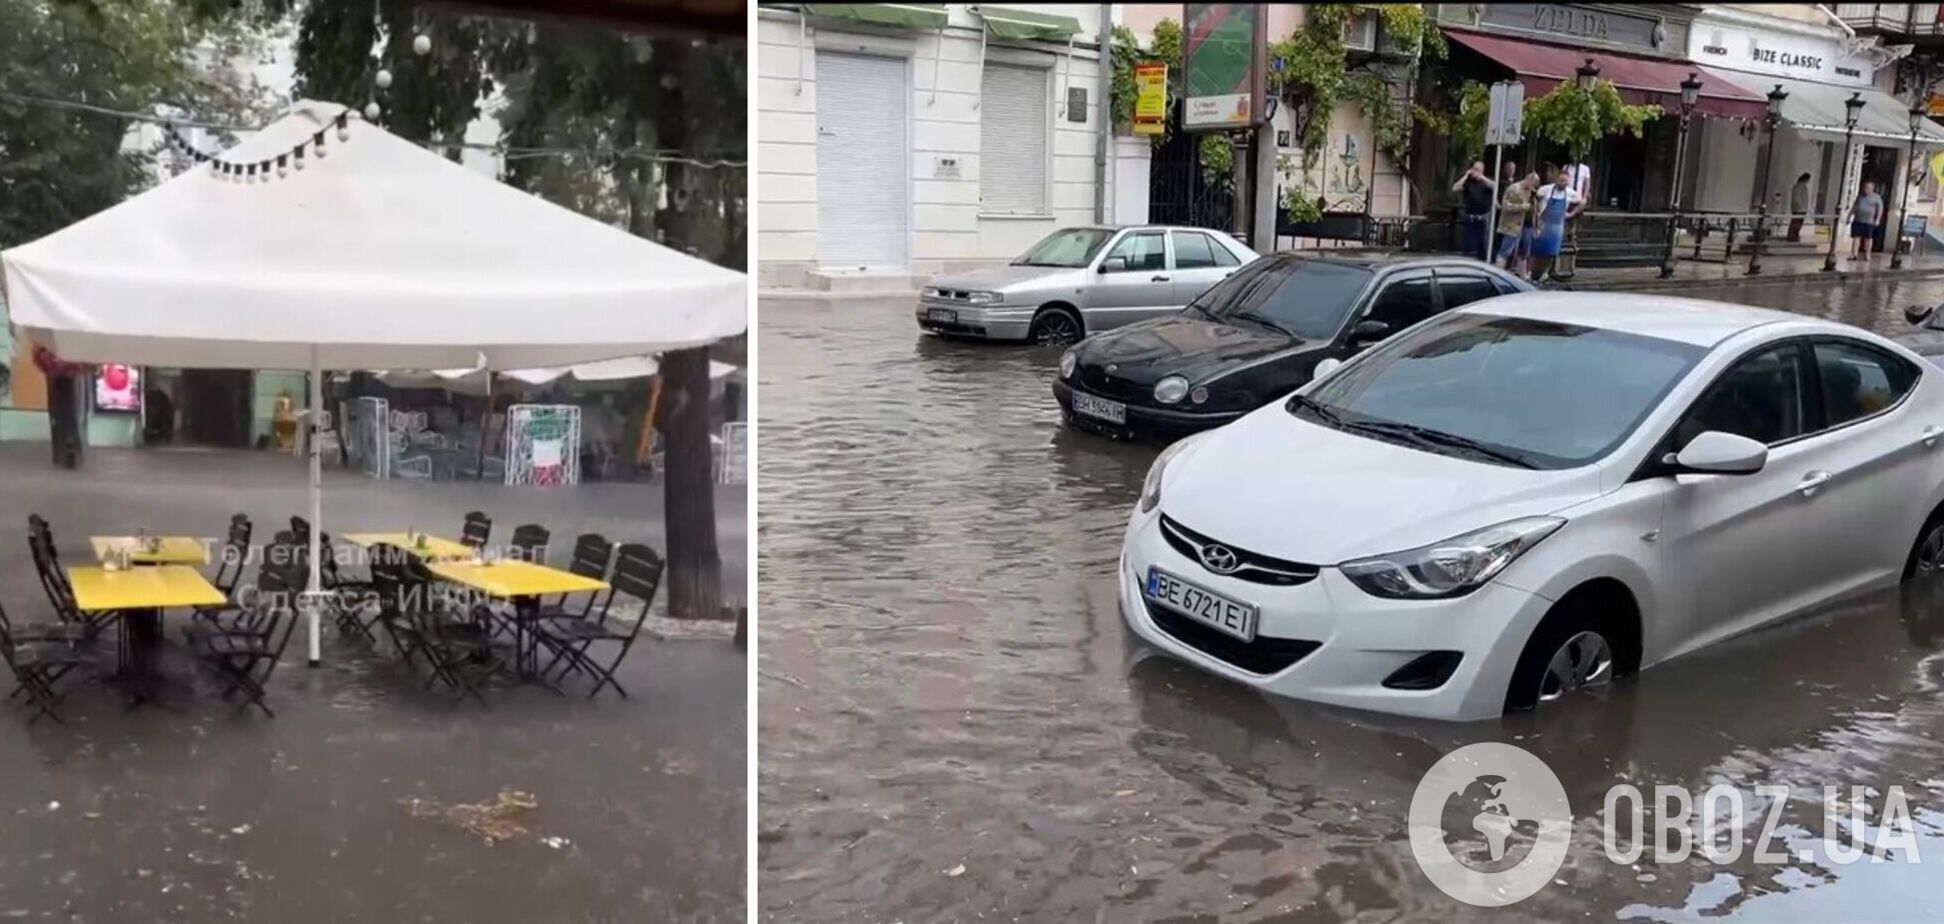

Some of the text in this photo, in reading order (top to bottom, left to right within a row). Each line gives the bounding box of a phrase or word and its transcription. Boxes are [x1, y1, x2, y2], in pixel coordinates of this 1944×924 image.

[1534, 5, 1609, 39] ZELDA
[1703, 45, 1728, 56] FRENCH
[1753, 48, 1823, 70] BIZE CLASSIC
[1157, 575, 1248, 633] BE 6721 EI
